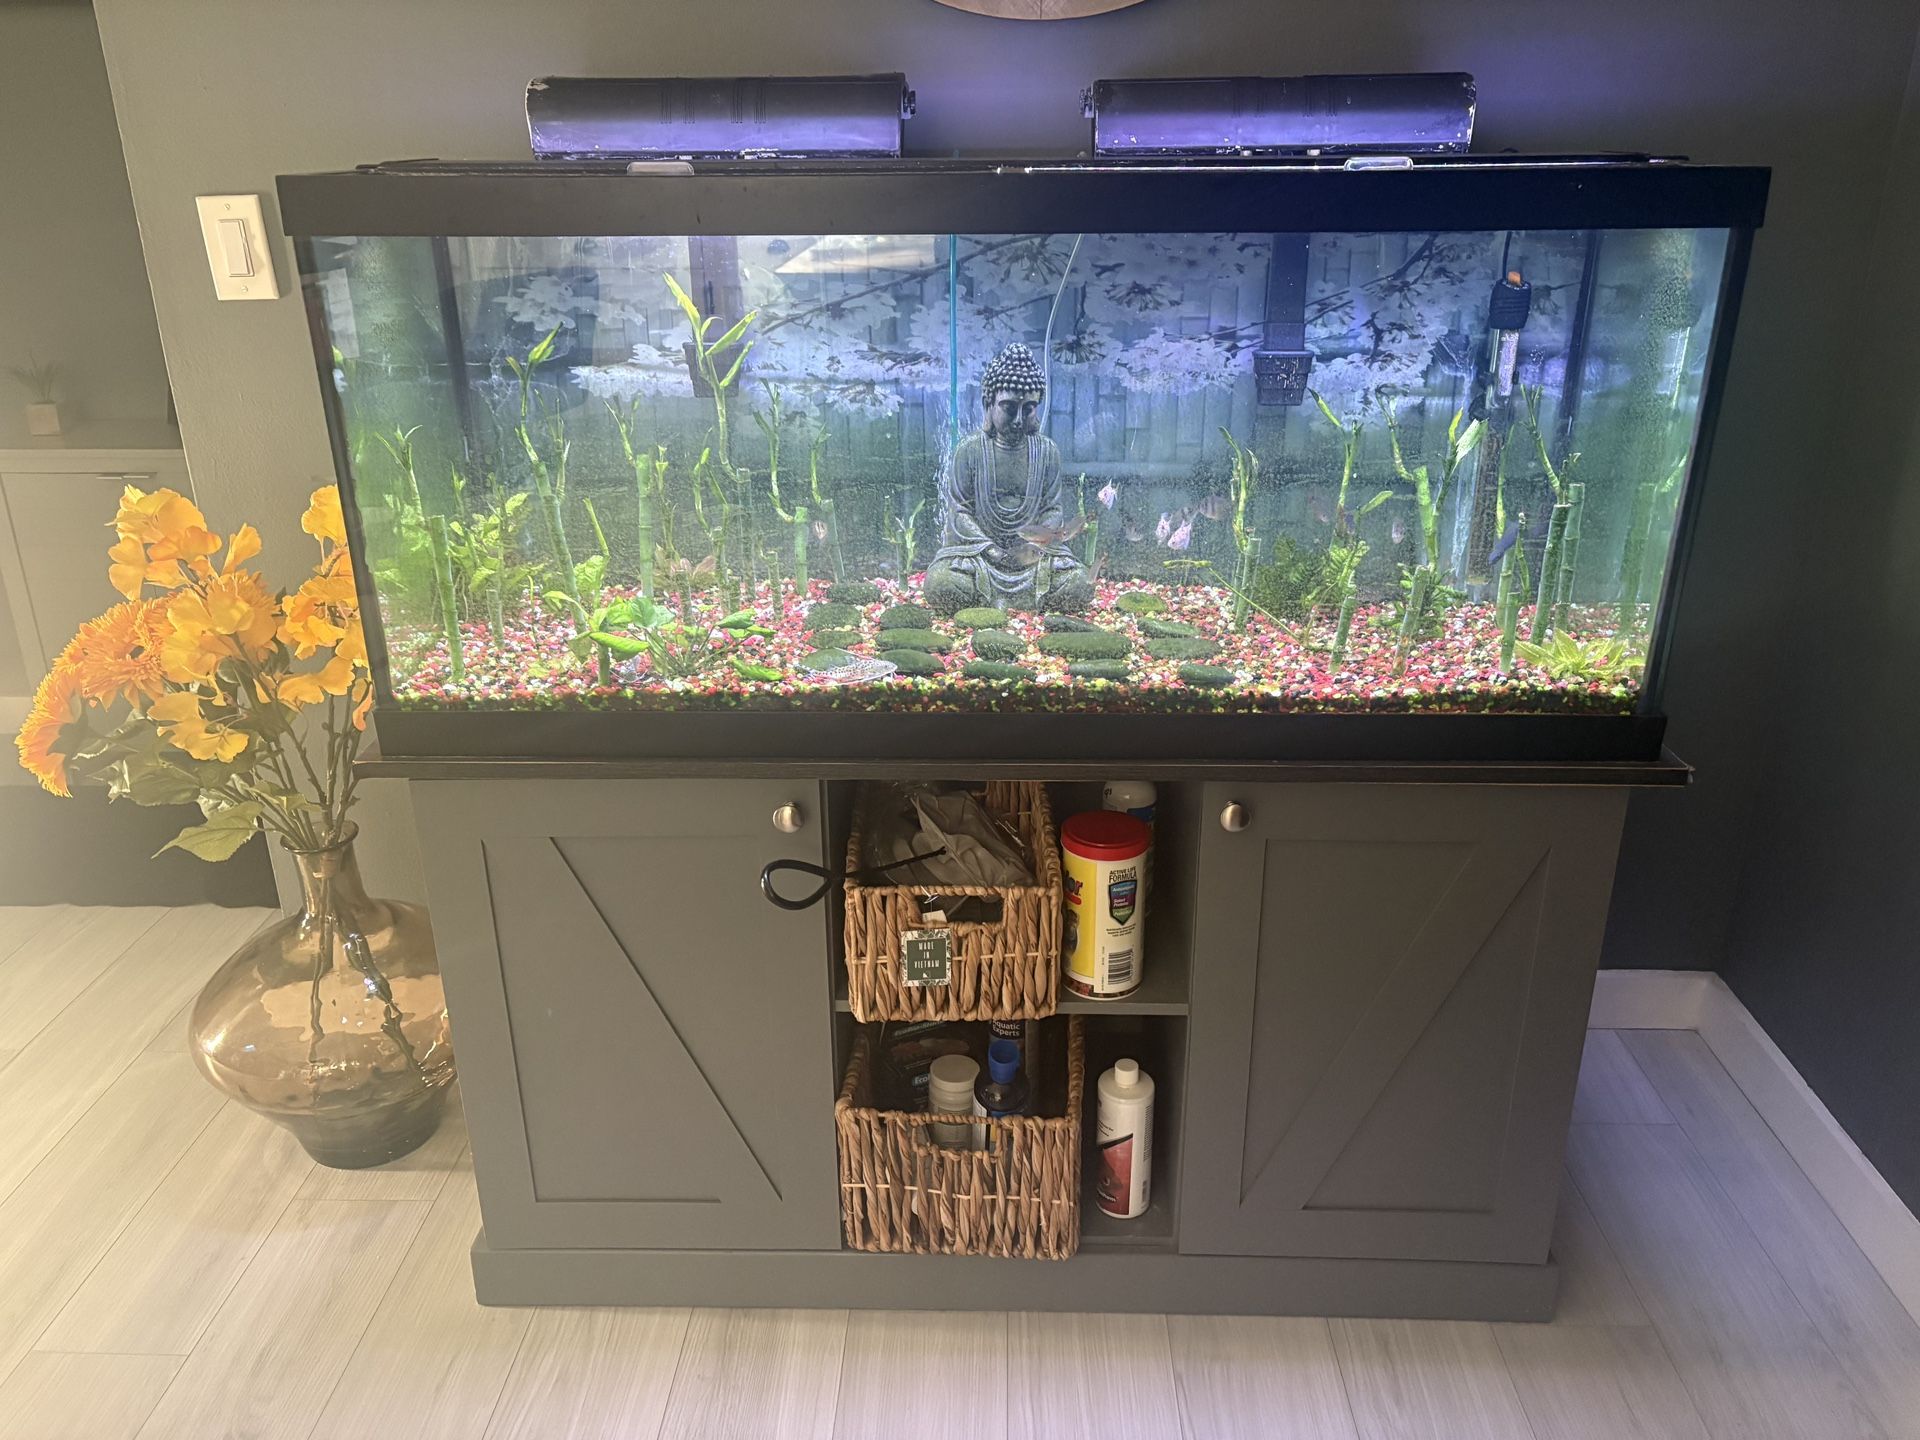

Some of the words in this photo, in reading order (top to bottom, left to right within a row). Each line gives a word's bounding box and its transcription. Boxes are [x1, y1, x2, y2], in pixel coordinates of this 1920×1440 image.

[1109, 870, 1137, 883] FORMULA
[918, 942, 935, 950] MADE
[923, 952, 930, 960] IN
[914, 960, 940, 969] VIETNAM
[992, 1025, 1020, 1036] Experts
